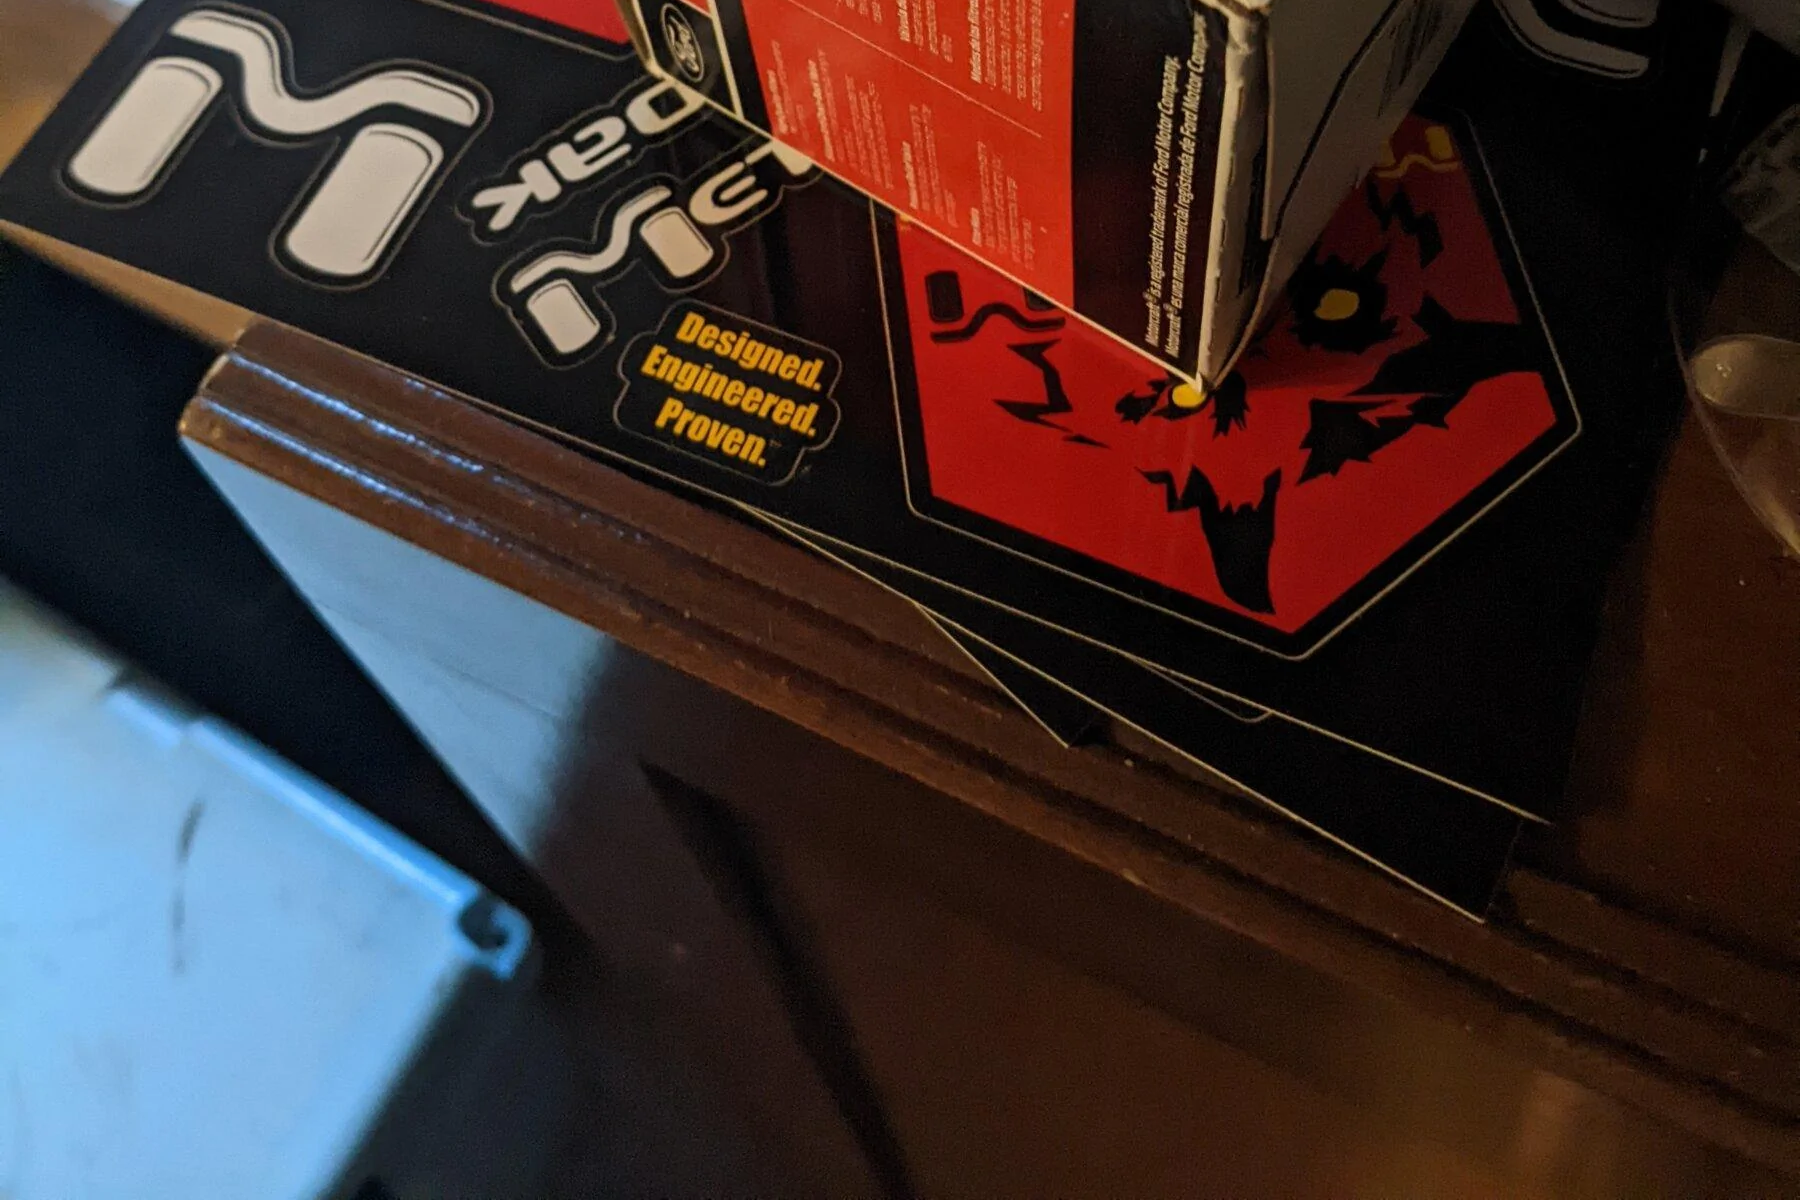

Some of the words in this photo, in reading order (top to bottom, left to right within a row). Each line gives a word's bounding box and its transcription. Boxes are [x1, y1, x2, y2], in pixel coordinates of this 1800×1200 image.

[1157, 55, 1181, 116] Company.
[1182, 71, 1202, 113] Motor
[1155, 111, 1173, 151] Motor
[1178, 136, 1196, 155] de
[1179, 107, 1198, 140] Ford
[1151, 170, 1168, 188] of
[1153, 145, 1170, 176] Ford
[1175, 152, 1195, 209] registrada
[1150, 185, 1168, 239] trademark
[1173, 203, 1190, 254] comercial
[1147, 233, 1166, 284] registered
[1172, 251, 1186, 282] marca
[675, 311, 824, 392] Designed.
[640, 344, 820, 438] Engineered.
[655, 397, 767, 468] Proven.
